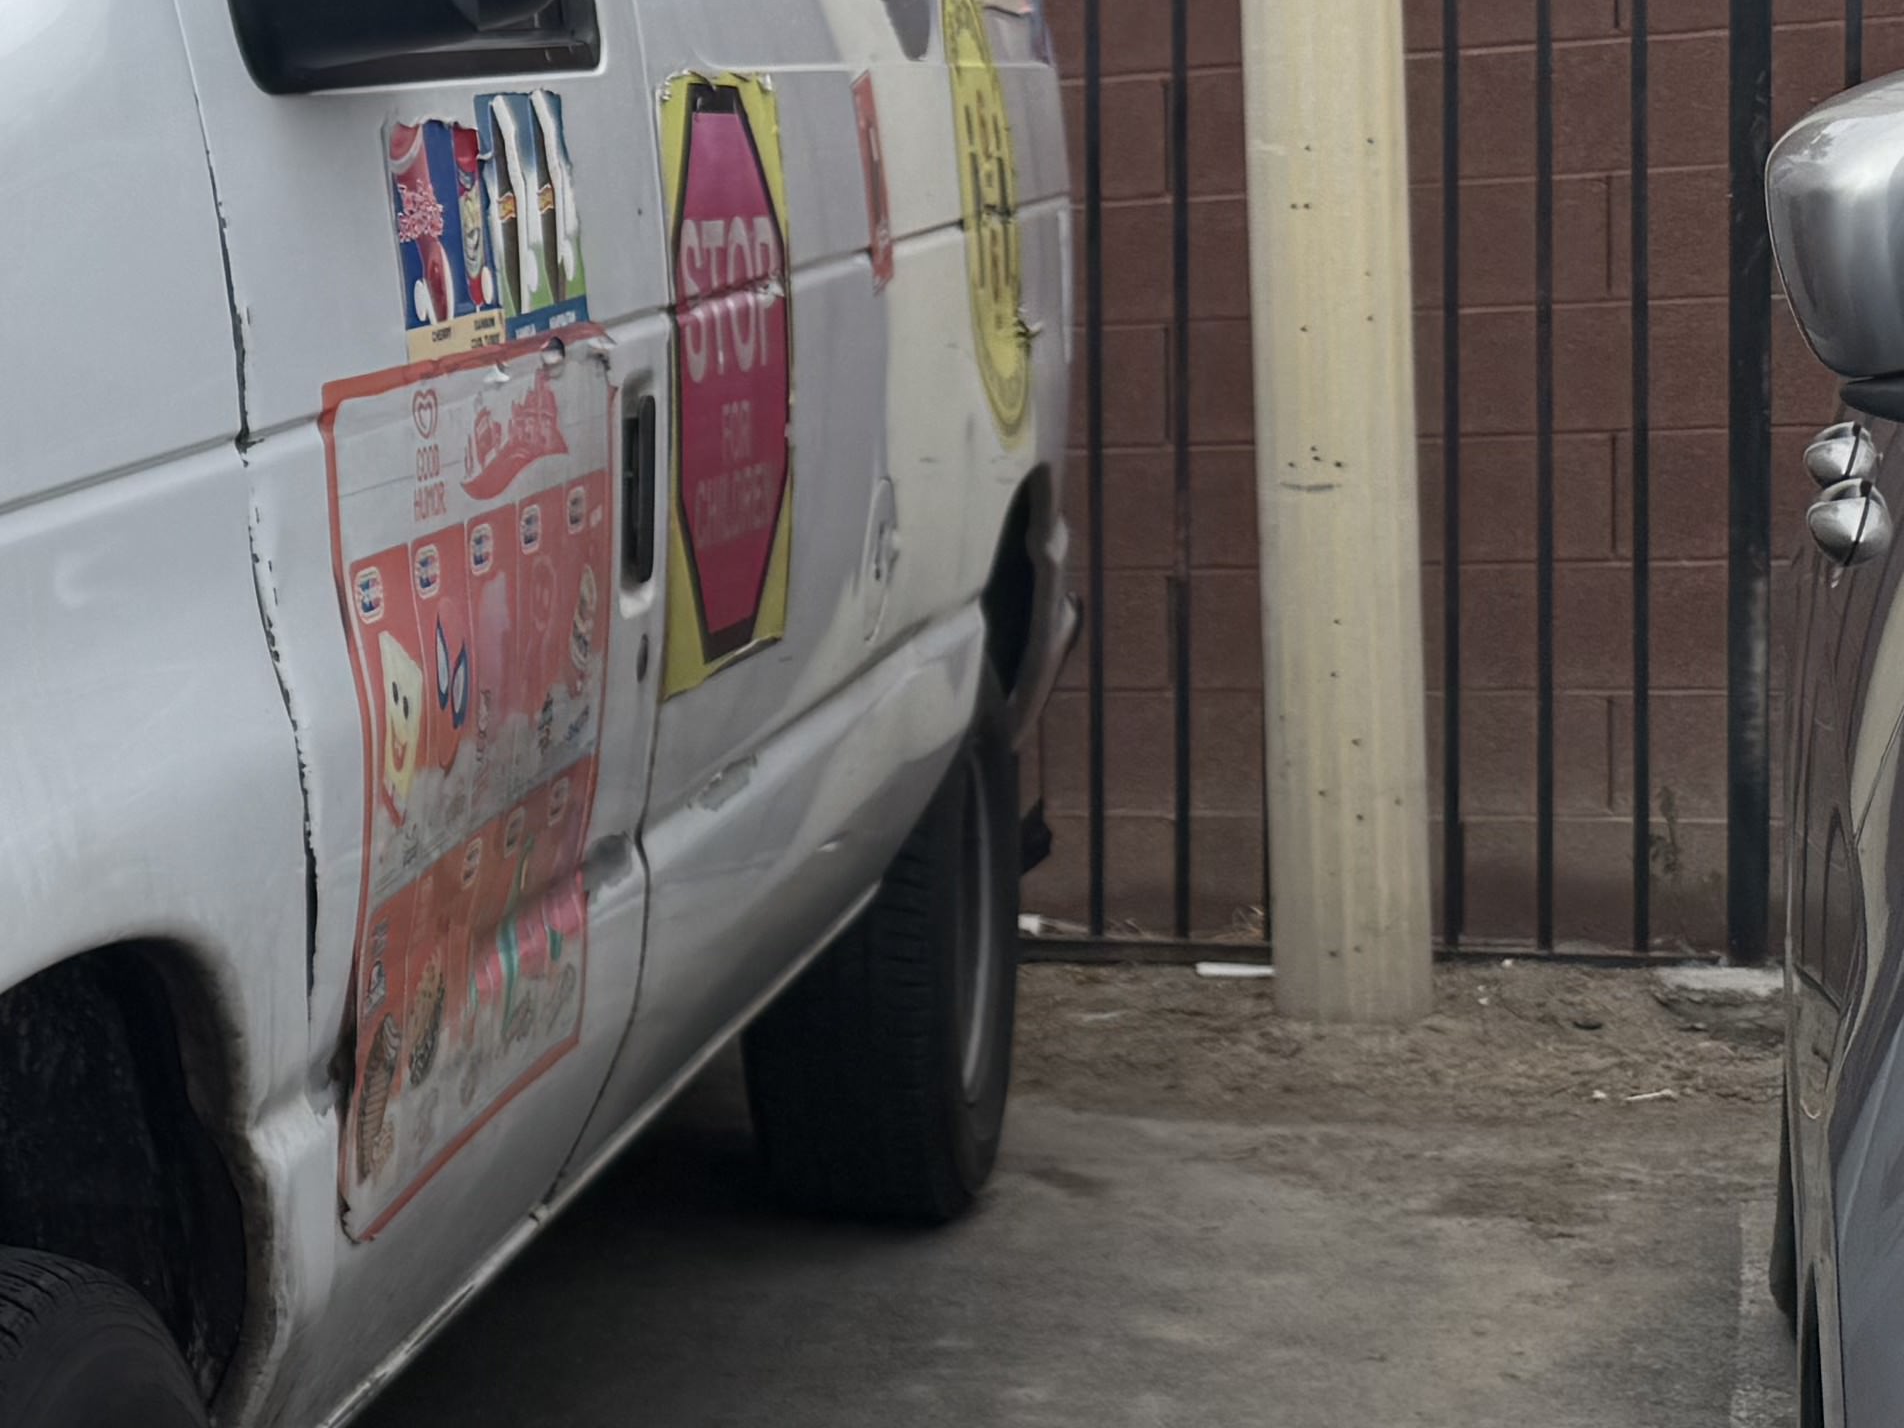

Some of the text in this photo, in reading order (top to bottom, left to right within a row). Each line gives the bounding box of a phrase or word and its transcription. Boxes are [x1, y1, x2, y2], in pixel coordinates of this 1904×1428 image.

[679, 215, 780, 383] STOP
[720, 400, 753, 462] FOR
[415, 443, 440, 483] GOOD
[414, 481, 447, 522] HUMOR
[693, 461, 775, 550] CHILDREN
